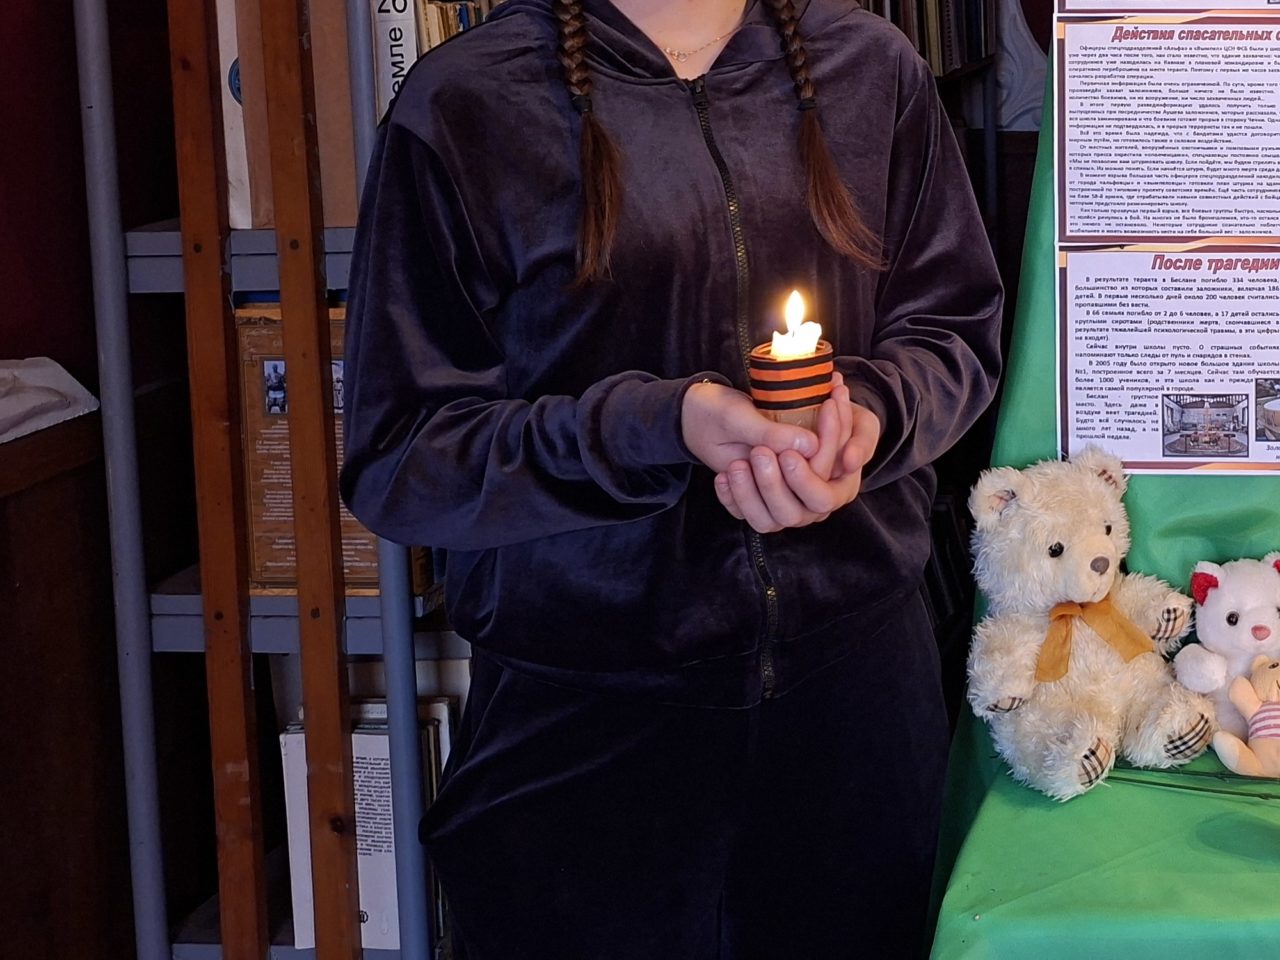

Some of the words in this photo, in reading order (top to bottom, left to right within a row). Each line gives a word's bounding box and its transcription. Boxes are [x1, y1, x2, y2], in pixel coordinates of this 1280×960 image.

[1112, 26, 1174, 42] Действия
[1178, 30, 1271, 40] спасательных
[1151, 254, 1202, 270] После
[1208, 258, 1279, 272] трагедии
